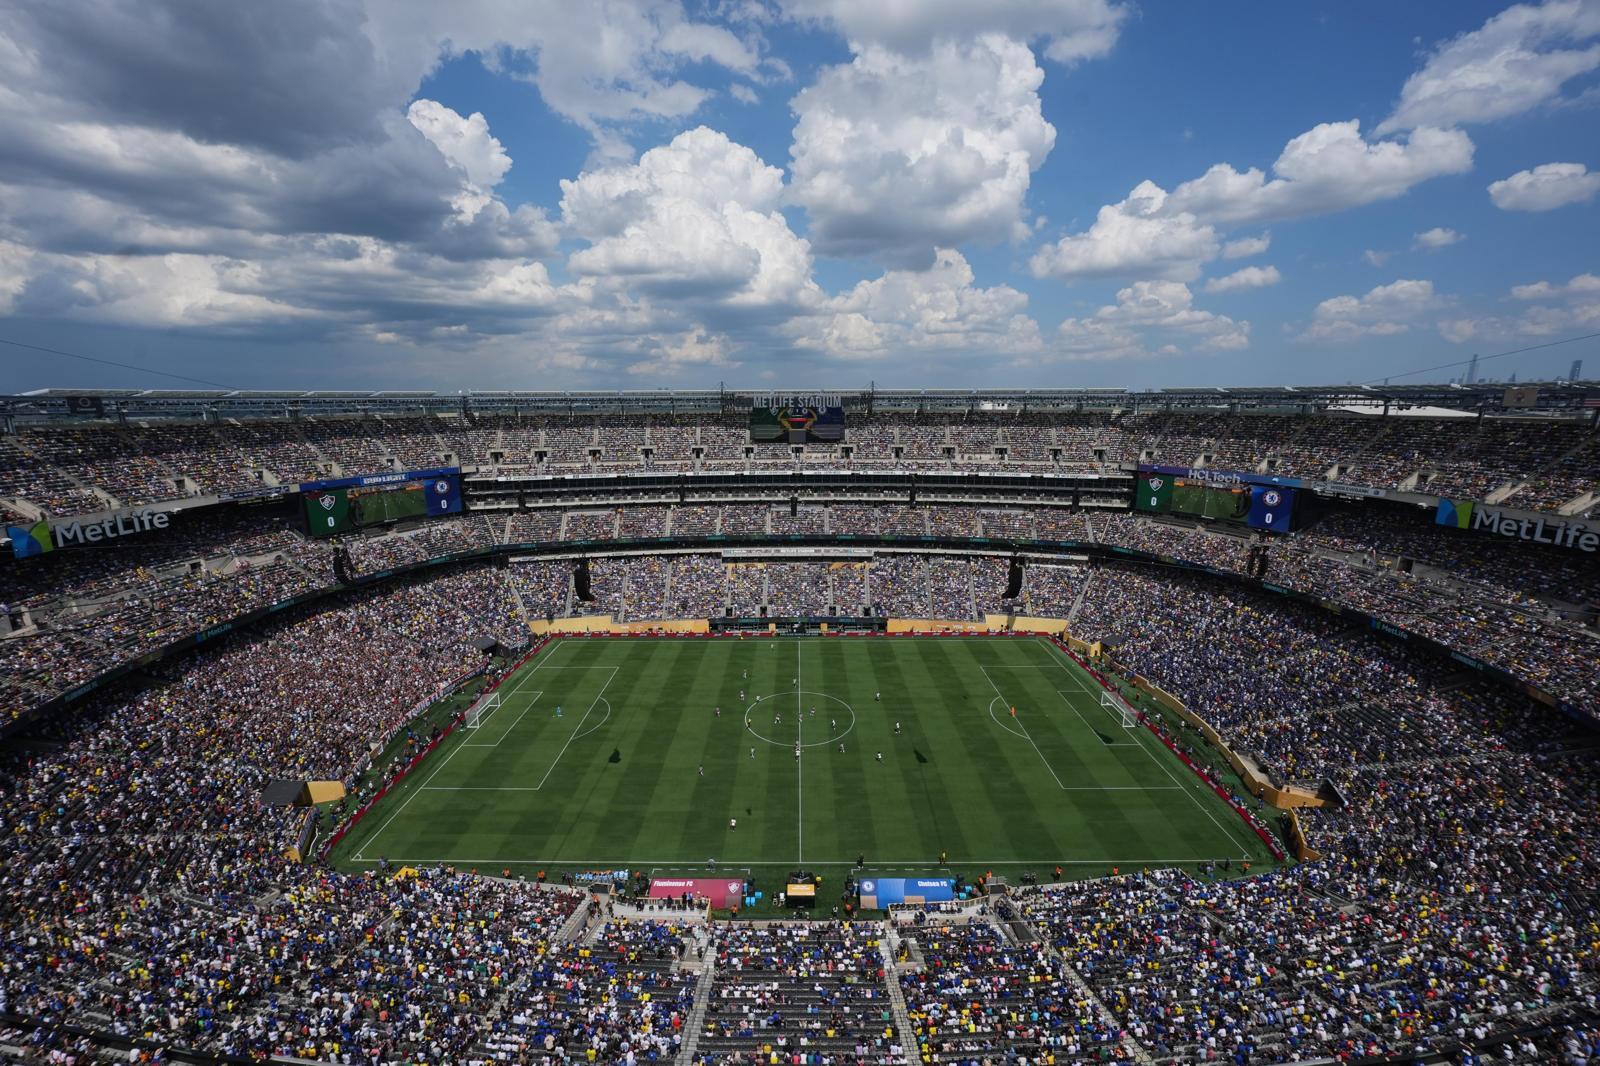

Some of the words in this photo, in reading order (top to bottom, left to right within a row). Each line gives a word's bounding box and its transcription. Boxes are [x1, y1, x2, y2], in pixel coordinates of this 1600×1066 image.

[753, 396, 794, 408] METLIFE
[798, 396, 842, 408] STADIUM
[1188, 469, 1241, 484] HCLTech
[441, 499, 448, 509] 0
[1151, 496, 1157, 506] 0
[327, 516, 335, 527] 0
[1265, 512, 1273, 524] 0
[56, 510, 170, 548] MetLife
[1473, 509, 1600, 553] MetLife
